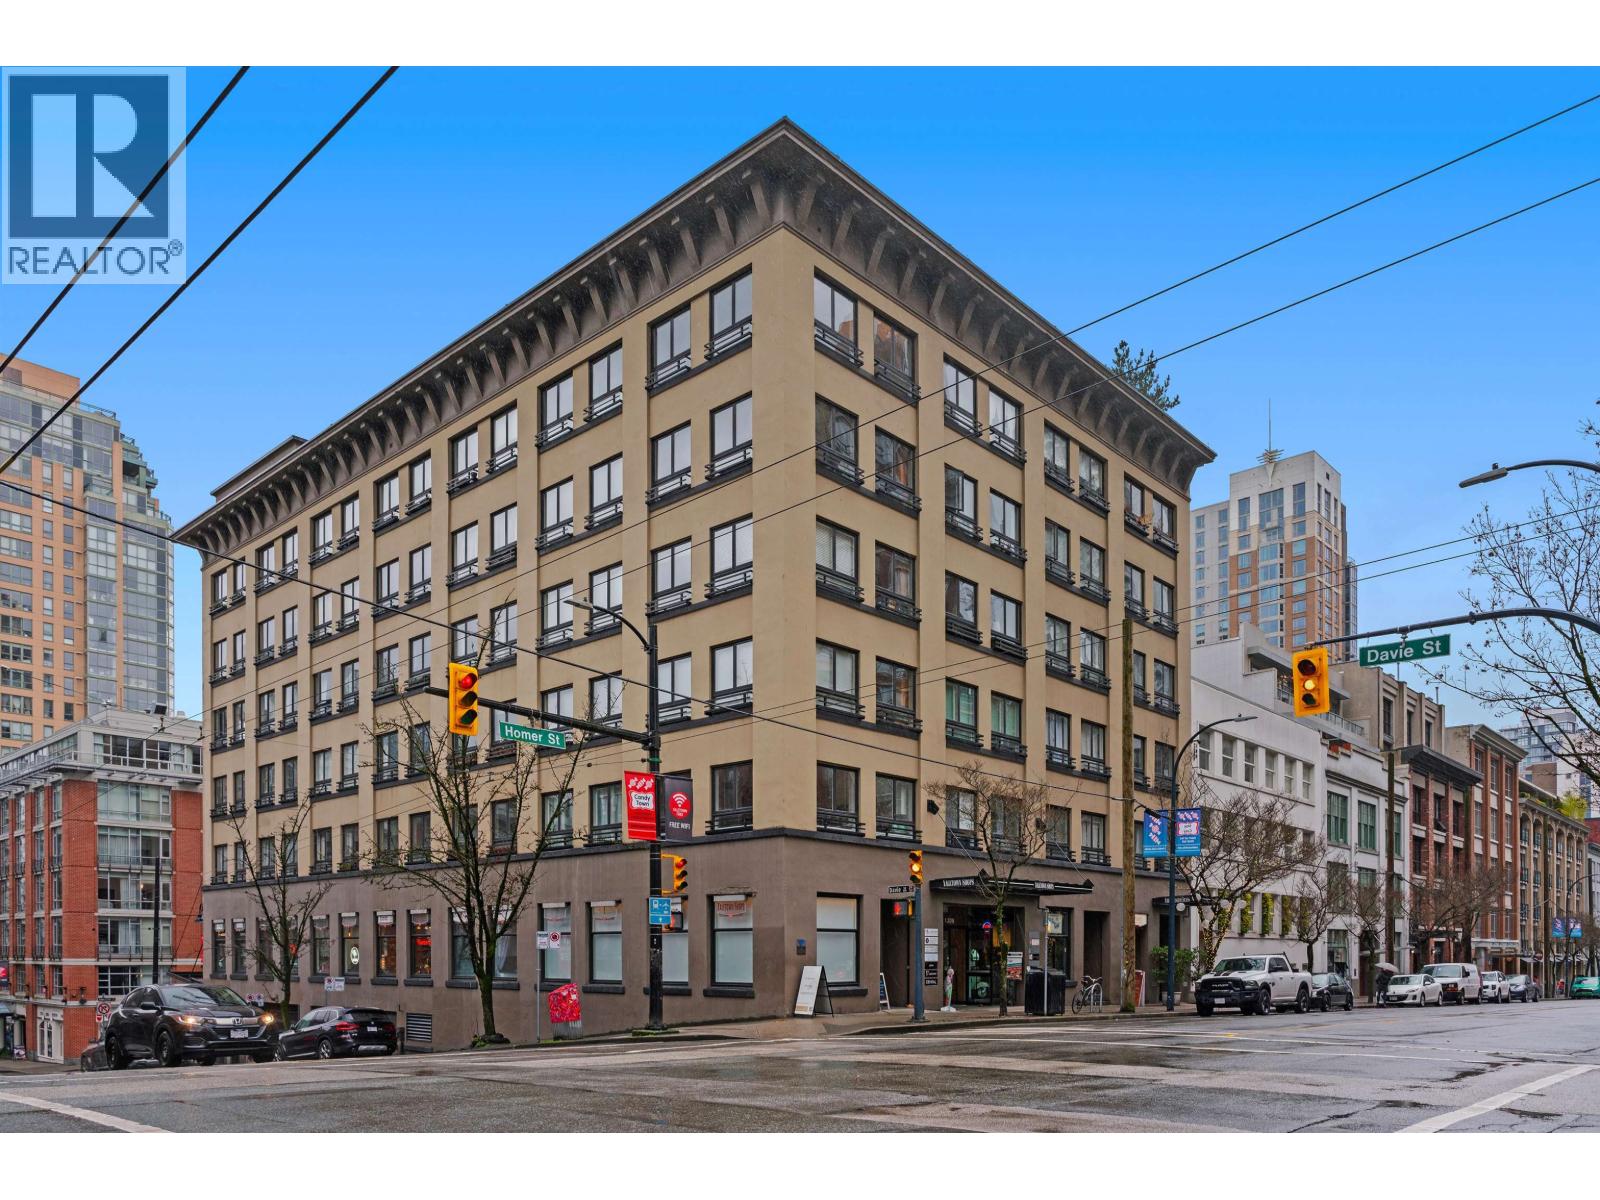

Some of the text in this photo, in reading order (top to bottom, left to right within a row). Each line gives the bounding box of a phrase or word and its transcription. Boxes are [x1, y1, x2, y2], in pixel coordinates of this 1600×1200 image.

[1367, 640, 1442, 663] Davie St
[505, 725, 560, 745] Homer St
[634, 794, 651, 802] Candy
[669, 821, 680, 829] FREE
